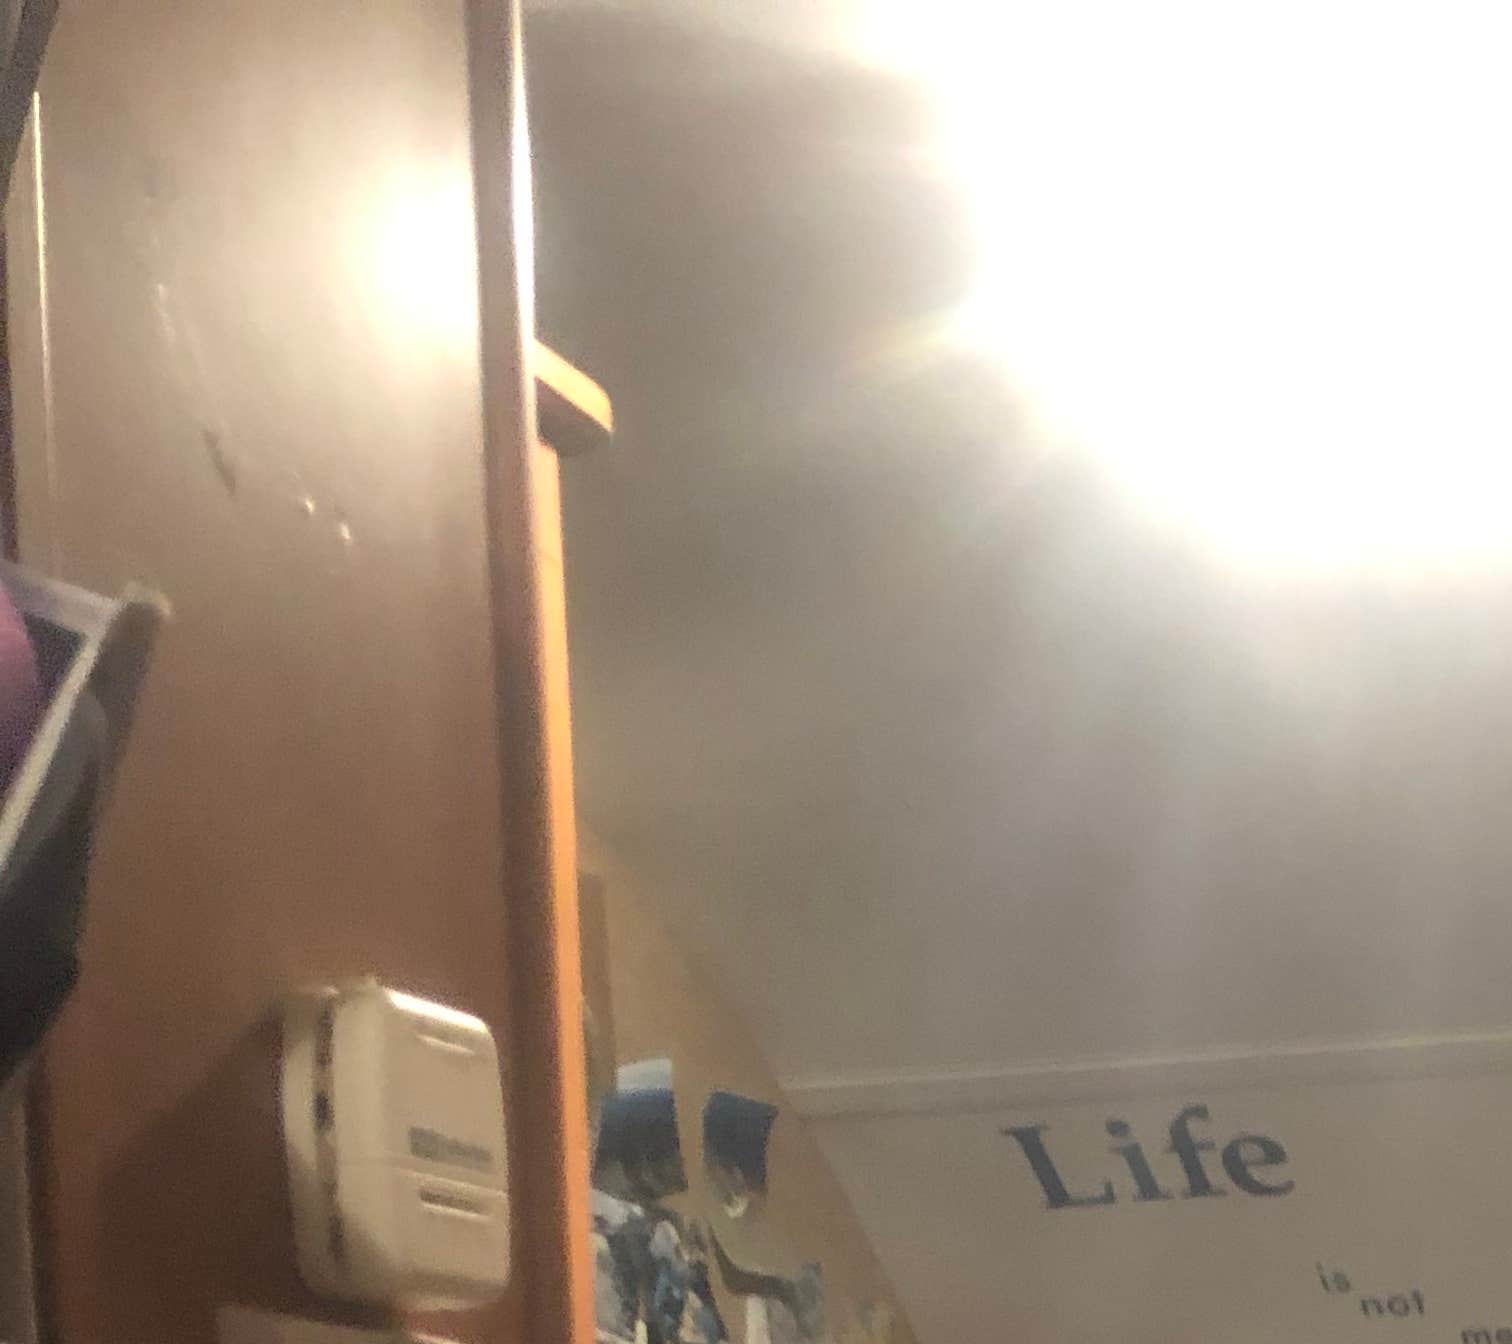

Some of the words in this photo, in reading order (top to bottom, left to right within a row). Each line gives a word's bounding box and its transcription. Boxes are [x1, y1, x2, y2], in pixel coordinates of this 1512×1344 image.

[1002, 1104, 1295, 1210] Life
[1315, 1261, 1352, 1293] is
[1360, 1288, 1425, 1316] not
